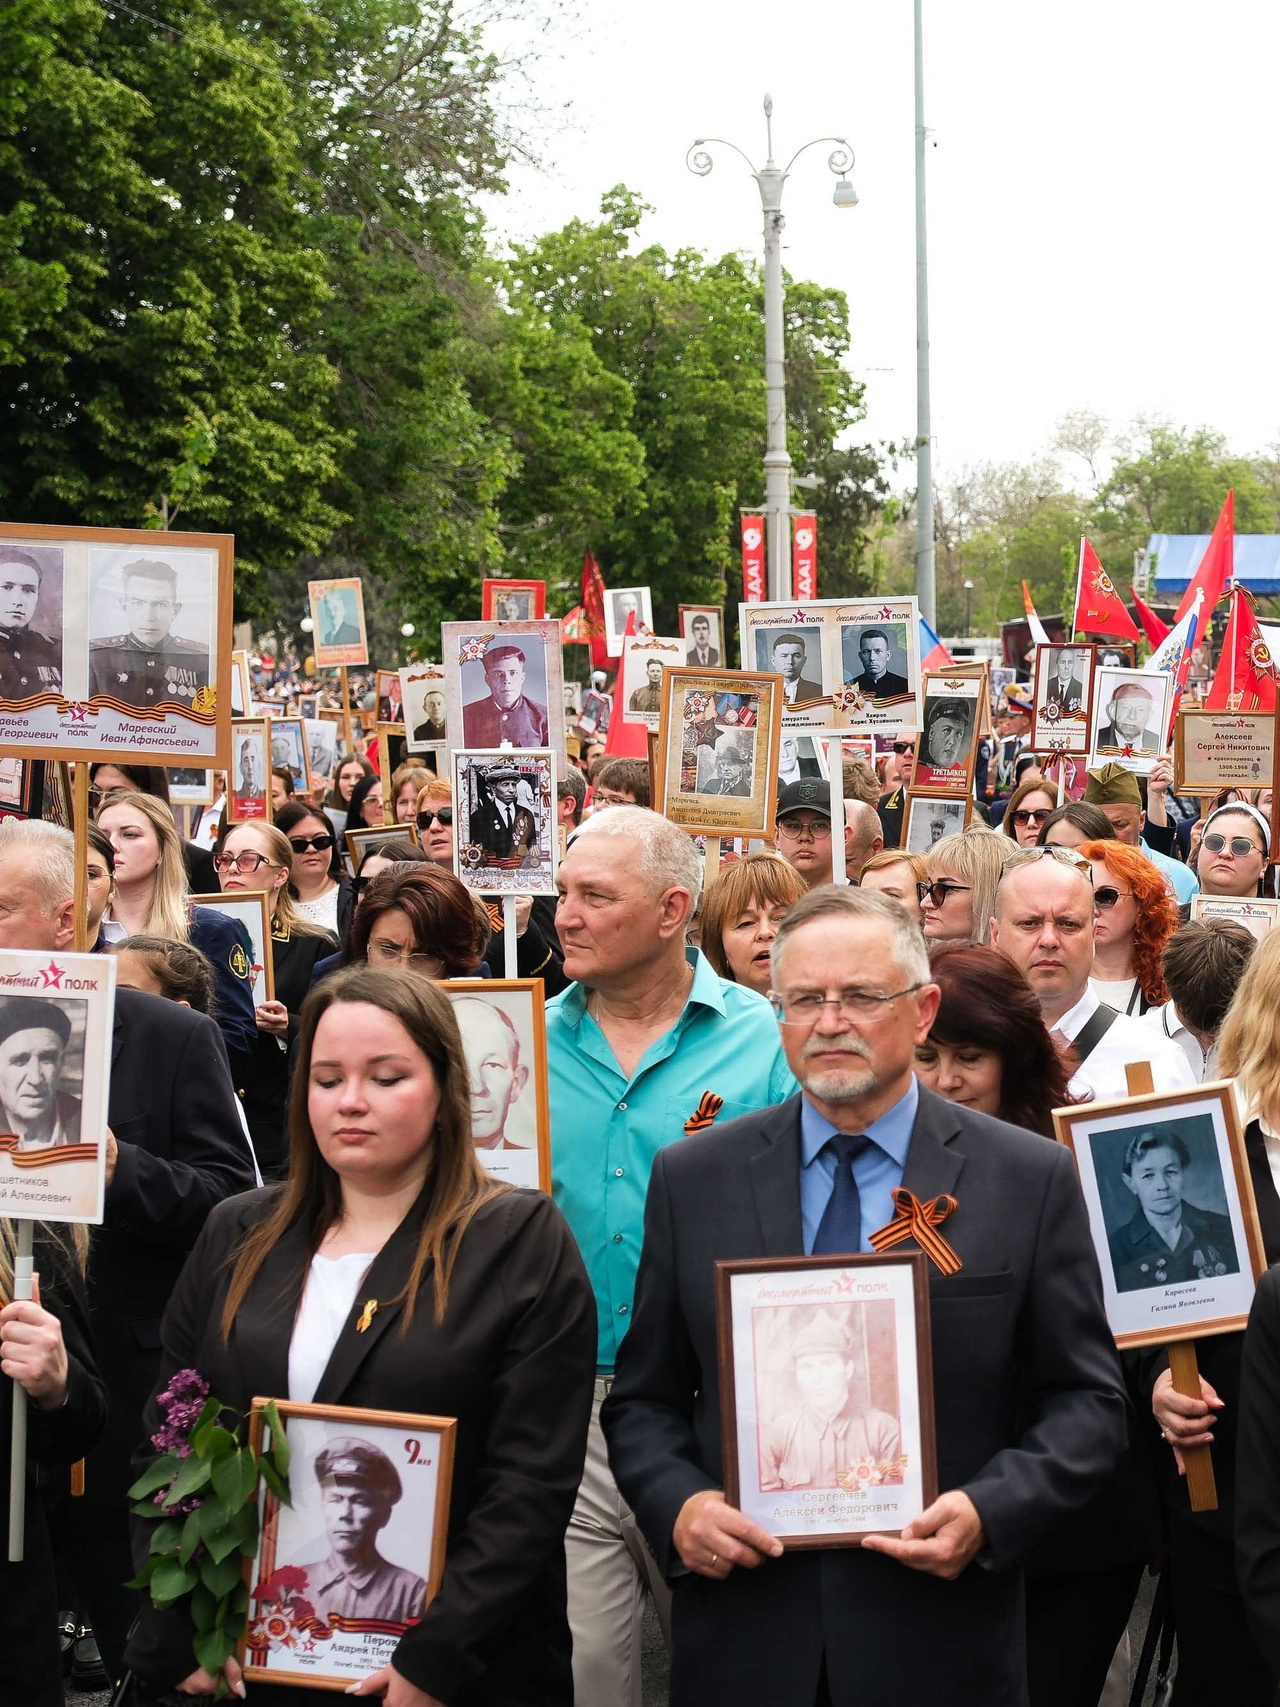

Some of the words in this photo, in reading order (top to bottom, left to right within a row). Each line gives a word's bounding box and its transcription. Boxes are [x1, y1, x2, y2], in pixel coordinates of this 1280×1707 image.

[743, 527, 762, 551] 9
[795, 527, 814, 551] 9
[117, 722, 177, 735] Маревский
[100, 733, 127, 744] Иван
[128, 734, 200, 748] Афанасьевич
[1214, 732, 1253, 740] Алексеев
[1197, 742, 1226, 751] Сергей
[1227, 743, 1270, 752] Никитович
[10, 1190, 72, 1203] Алексеевич
[1151, 1303, 1177, 1313] Галина
[1178, 1296, 1216, 1309] Яковлевна
[404, 1438, 421, 1464] 9
[828, 1502, 899, 1516] Федорович
[363, 1634, 398, 1647] Перов
[330, 1642, 369, 1655] Андрей
[371, 1647, 393, 1656] Пет
